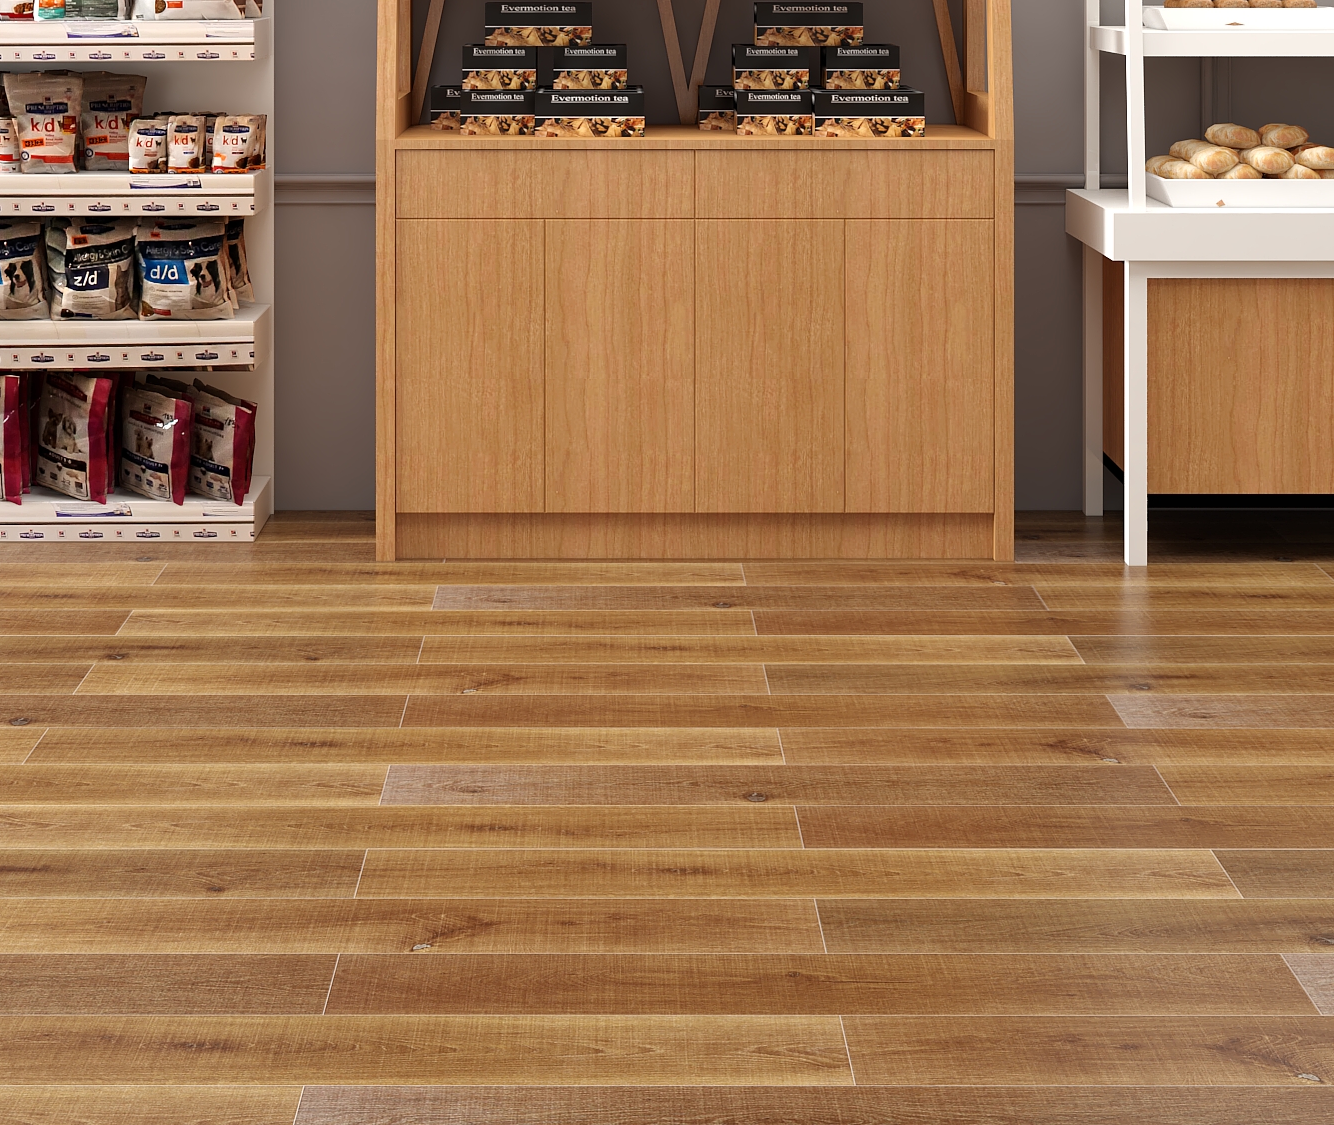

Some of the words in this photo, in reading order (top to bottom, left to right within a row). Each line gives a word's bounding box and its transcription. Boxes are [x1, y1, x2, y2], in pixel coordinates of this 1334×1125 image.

[31, 117, 55, 132] k/d
[95, 115, 118, 130] k/d
[15, 241, 37, 252] Care
[146, 245, 173, 257] Allergy
[200, 241, 222, 252] Care
[73, 251, 98, 262] Allergy
[105, 248, 120, 258] Skin
[73, 270, 98, 287] z/d
[150, 264, 179, 280] d/d
